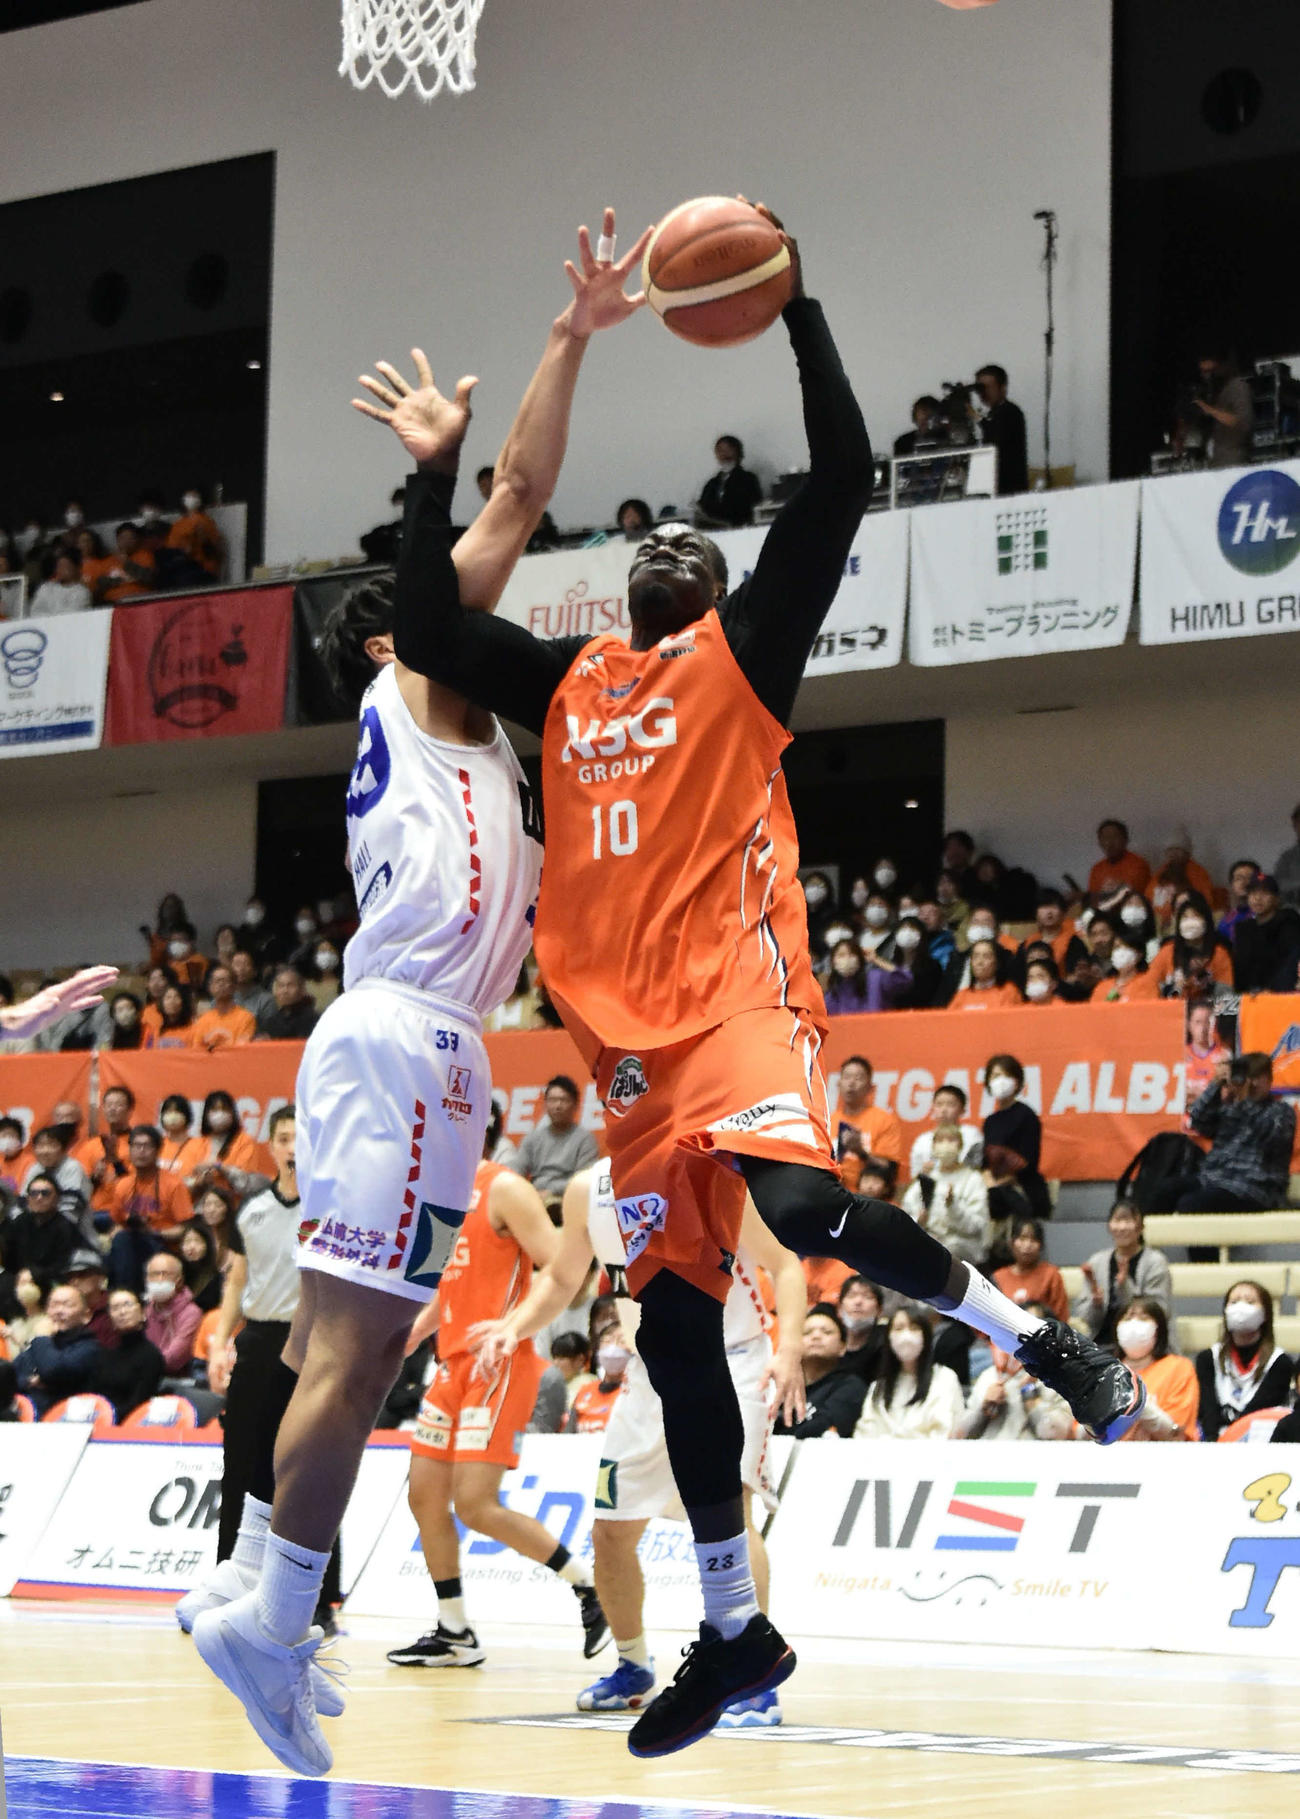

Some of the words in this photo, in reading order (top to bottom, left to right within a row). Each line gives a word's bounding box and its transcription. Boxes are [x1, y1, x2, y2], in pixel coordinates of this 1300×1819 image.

[1171, 601, 1245, 632] HIMU
[1257, 595, 1300, 625] GR
[562, 697, 677, 763] NSG
[578, 755, 656, 784] GROUP
[592, 799, 638, 860] 10
[832, 1479, 1141, 1553] NST
[66, 1547, 203, 1575] オムニ技研
[706, 1553, 734, 1572] 23
[814, 1571, 892, 1593] Niigata
[1011, 1577, 1072, 1598] Smile
[1079, 1579, 1109, 1599] TV
